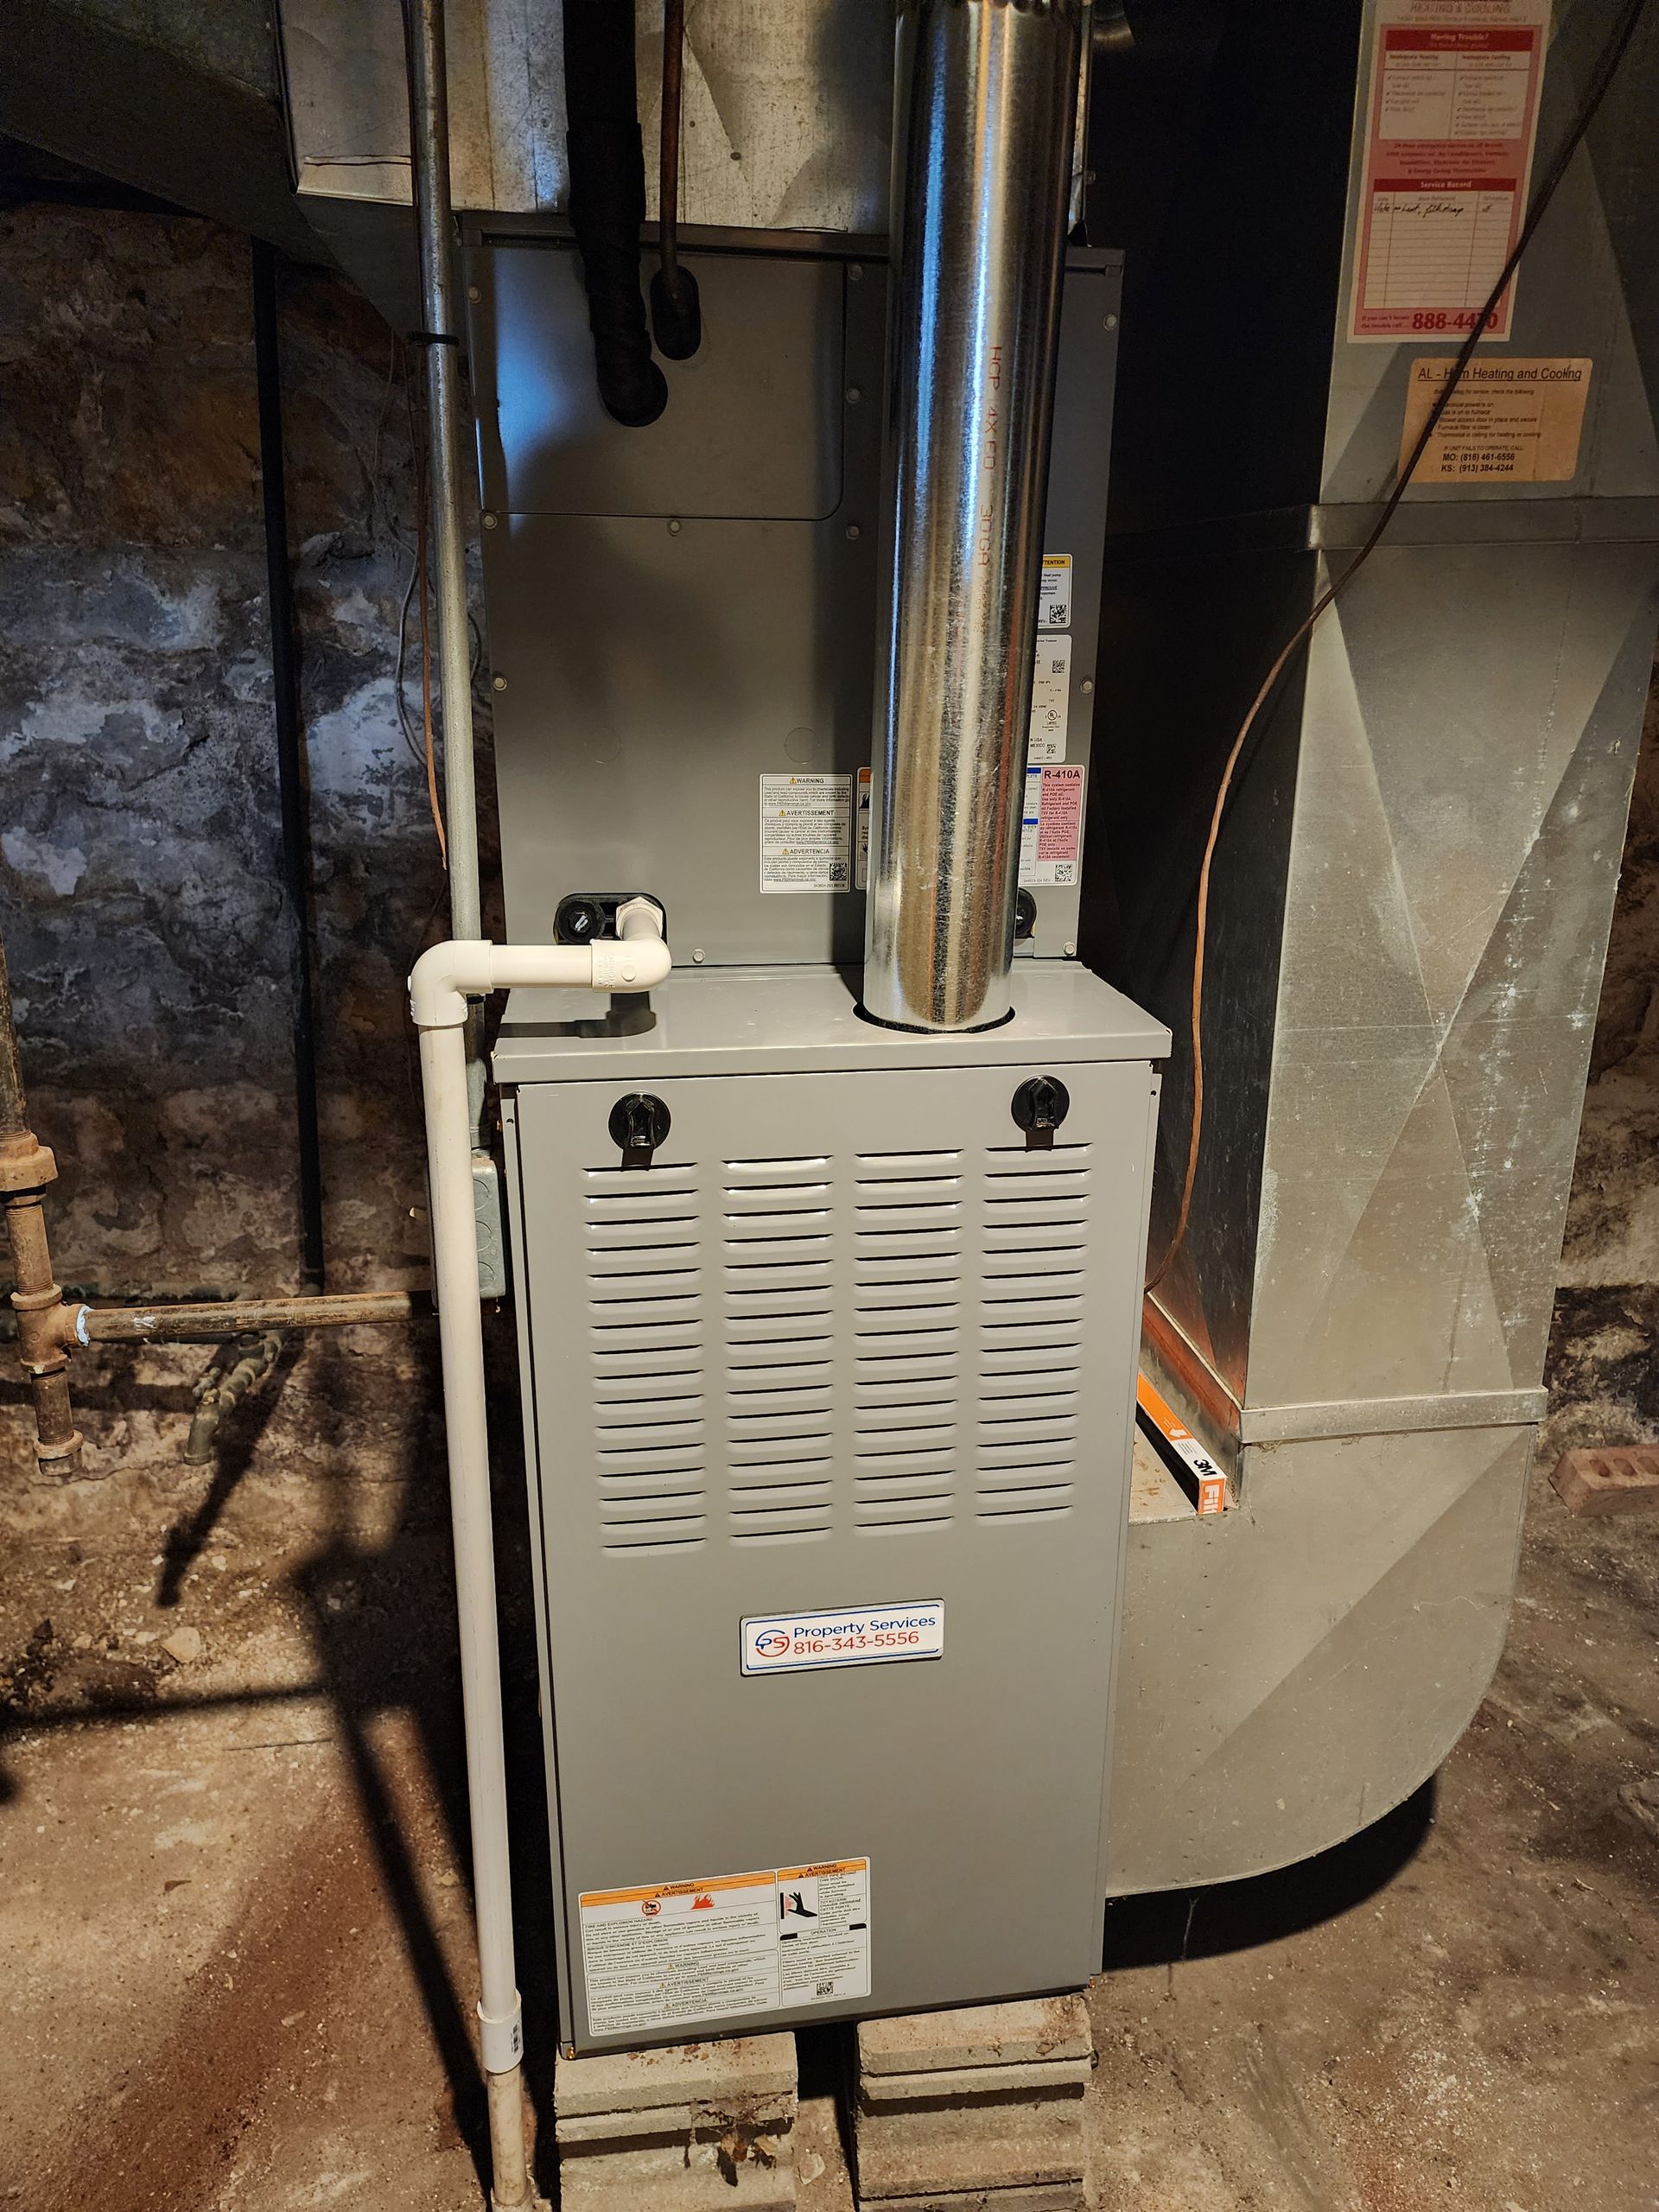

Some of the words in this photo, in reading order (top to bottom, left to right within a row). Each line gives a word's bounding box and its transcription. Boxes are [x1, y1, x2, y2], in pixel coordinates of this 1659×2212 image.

[1412, 313, 1498, 330] 888-440
[988, 346, 1002, 391] HCP
[1418, 368, 1432, 379] AL
[1444, 368, 1469, 379] Hm
[1473, 368, 1514, 381] Heating
[1517, 368, 1537, 379] and
[1541, 366, 1582, 381] Cooling
[1460, 453, 1479, 462] (816)
[1459, 464, 1478, 473] (913)
[1044, 770, 1080, 779] R-410A
[1194, 1459, 1217, 1477] 3M
[794, 1624, 864, 1638] Property
[869, 1617, 936, 1630] Services
[794, 1631, 919, 1655] 816-343-5556
[805, 1867, 846, 1878] AVERTISSEMENT
[661, 1887, 704, 1897] AVERTISSEMENT
[667, 1977, 709, 1986] AVERTISSEMENT
[671, 1998, 707, 2008] ADVERTENCIA
